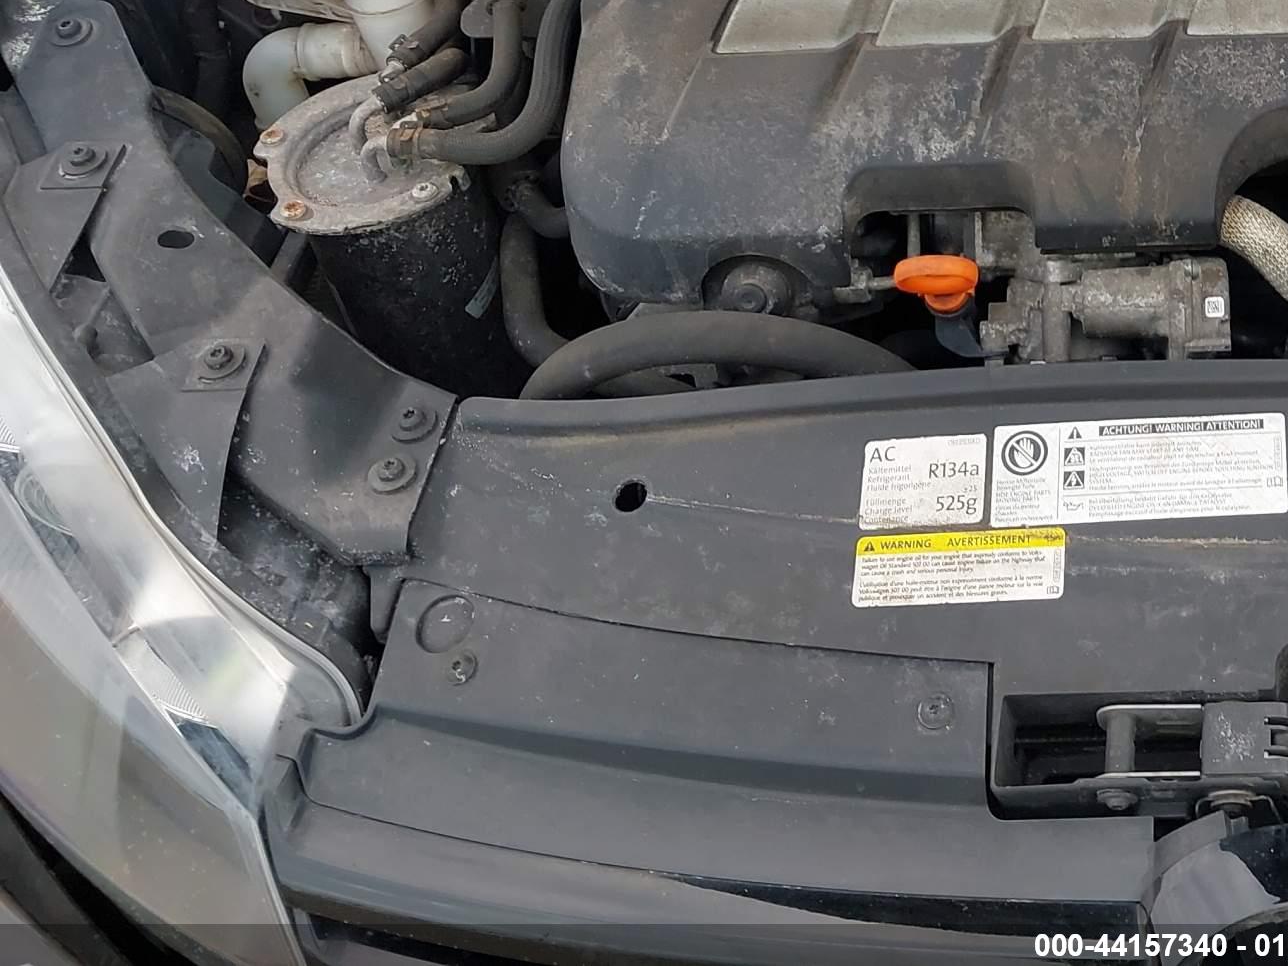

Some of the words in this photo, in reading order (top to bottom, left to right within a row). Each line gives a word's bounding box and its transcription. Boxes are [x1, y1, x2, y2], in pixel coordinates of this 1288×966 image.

[1102, 423, 1152, 436] ACHTUNG!
[1155, 421, 1204, 433] WARNING!
[1206, 419, 1261, 431] ATTENTION!
[869, 446, 896, 463] AC
[928, 461, 980, 479] R134a
[867, 474, 910, 484] Refrigerant
[935, 495, 978, 515] 525g
[880, 538, 932, 550] WARNING
[947, 534, 1031, 547] AVERTISSEMENT
